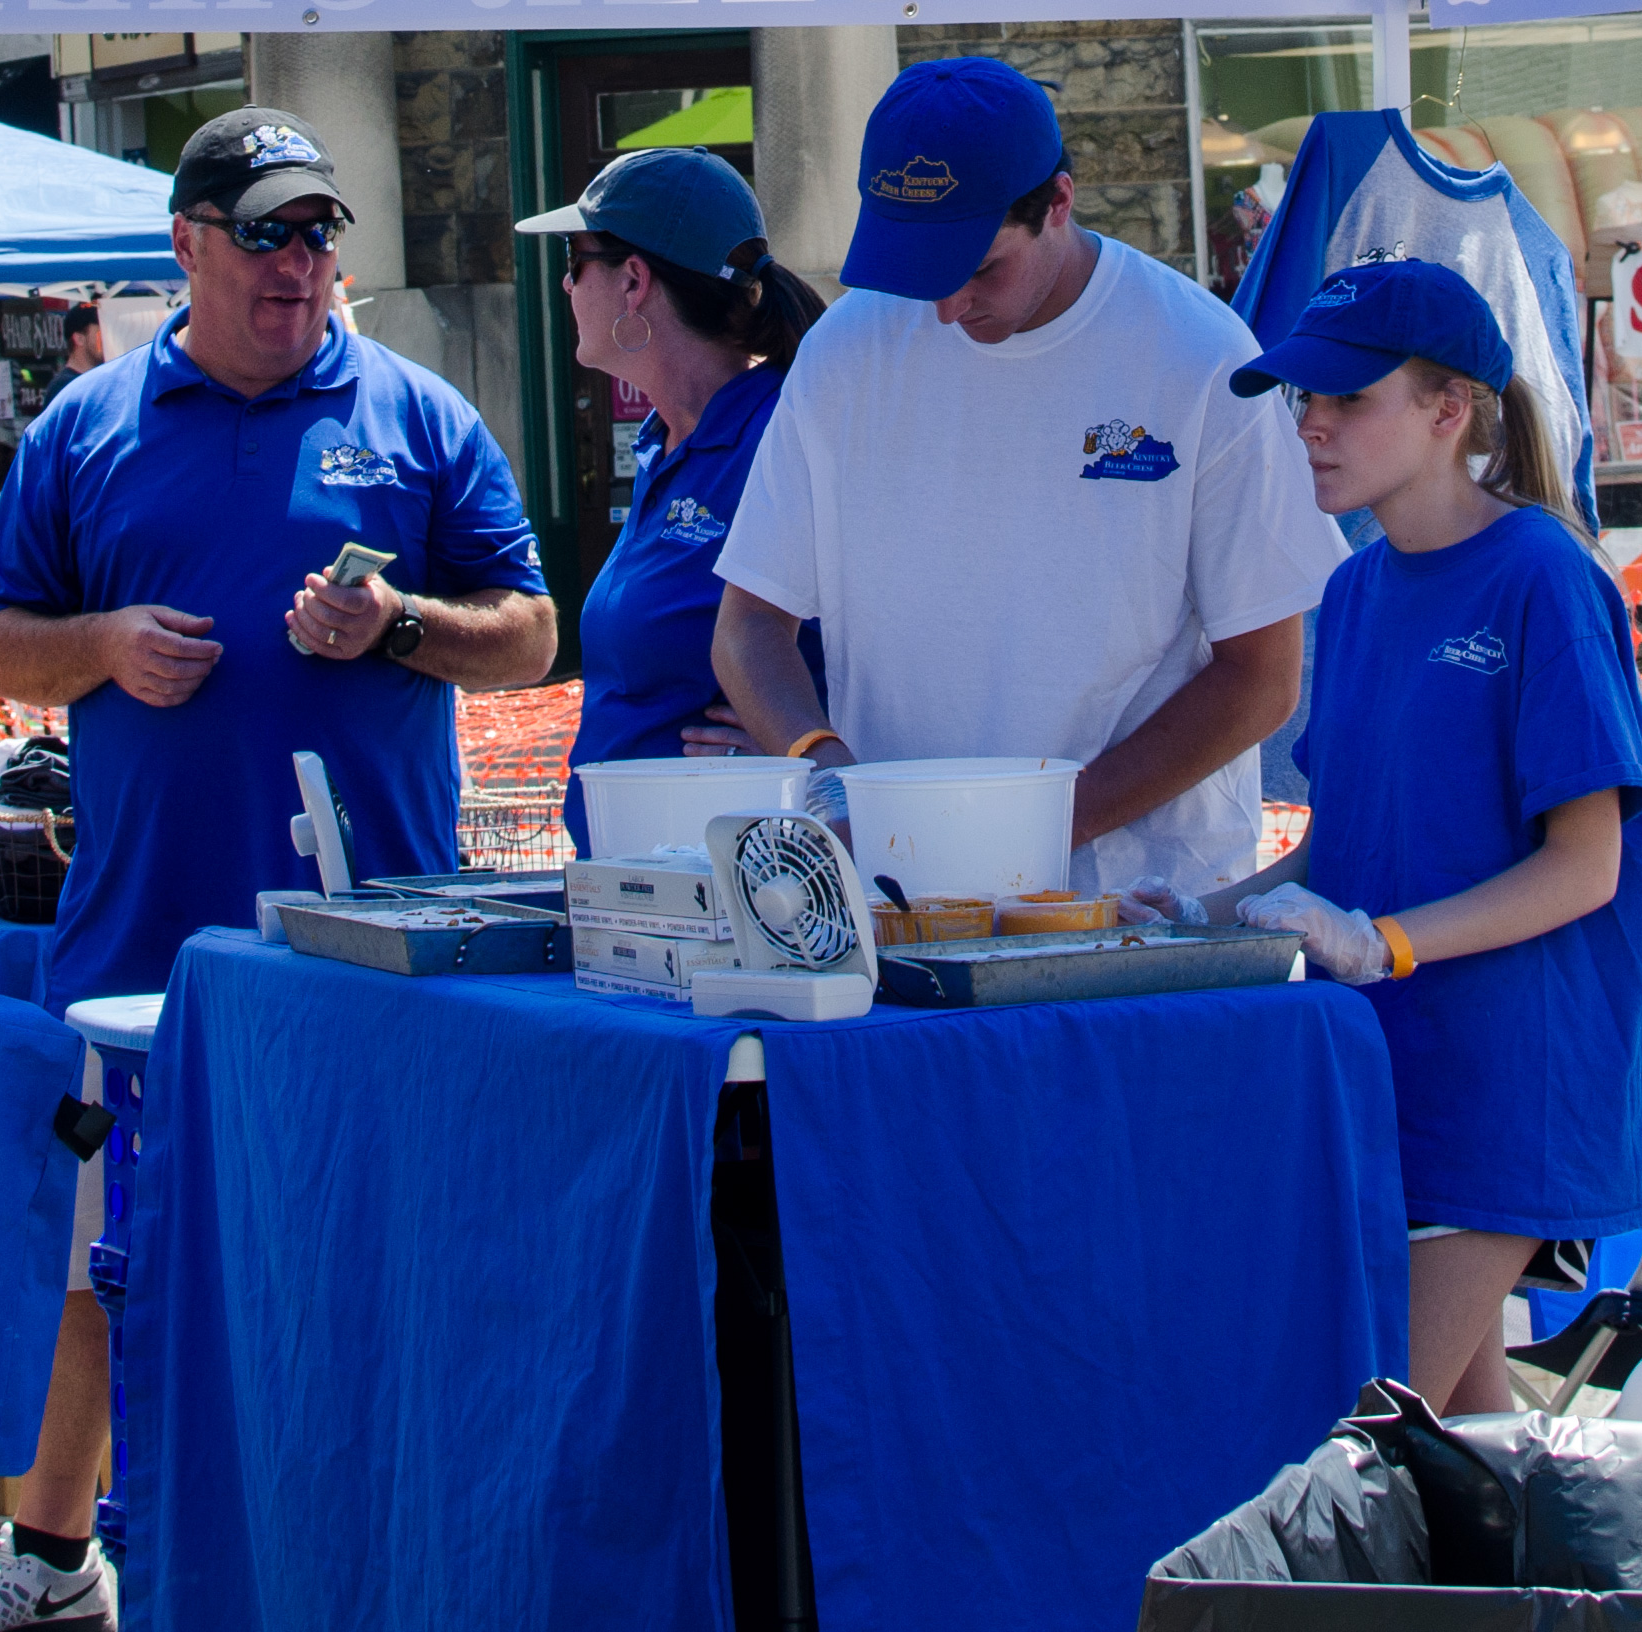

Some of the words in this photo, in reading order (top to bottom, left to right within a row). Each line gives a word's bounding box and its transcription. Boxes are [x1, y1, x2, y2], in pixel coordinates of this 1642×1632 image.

[904, 175, 949, 187] KENTUCKY
[902, 186, 937, 198] CHEESE
[1132, 452, 1171, 463] KENTUCKY
